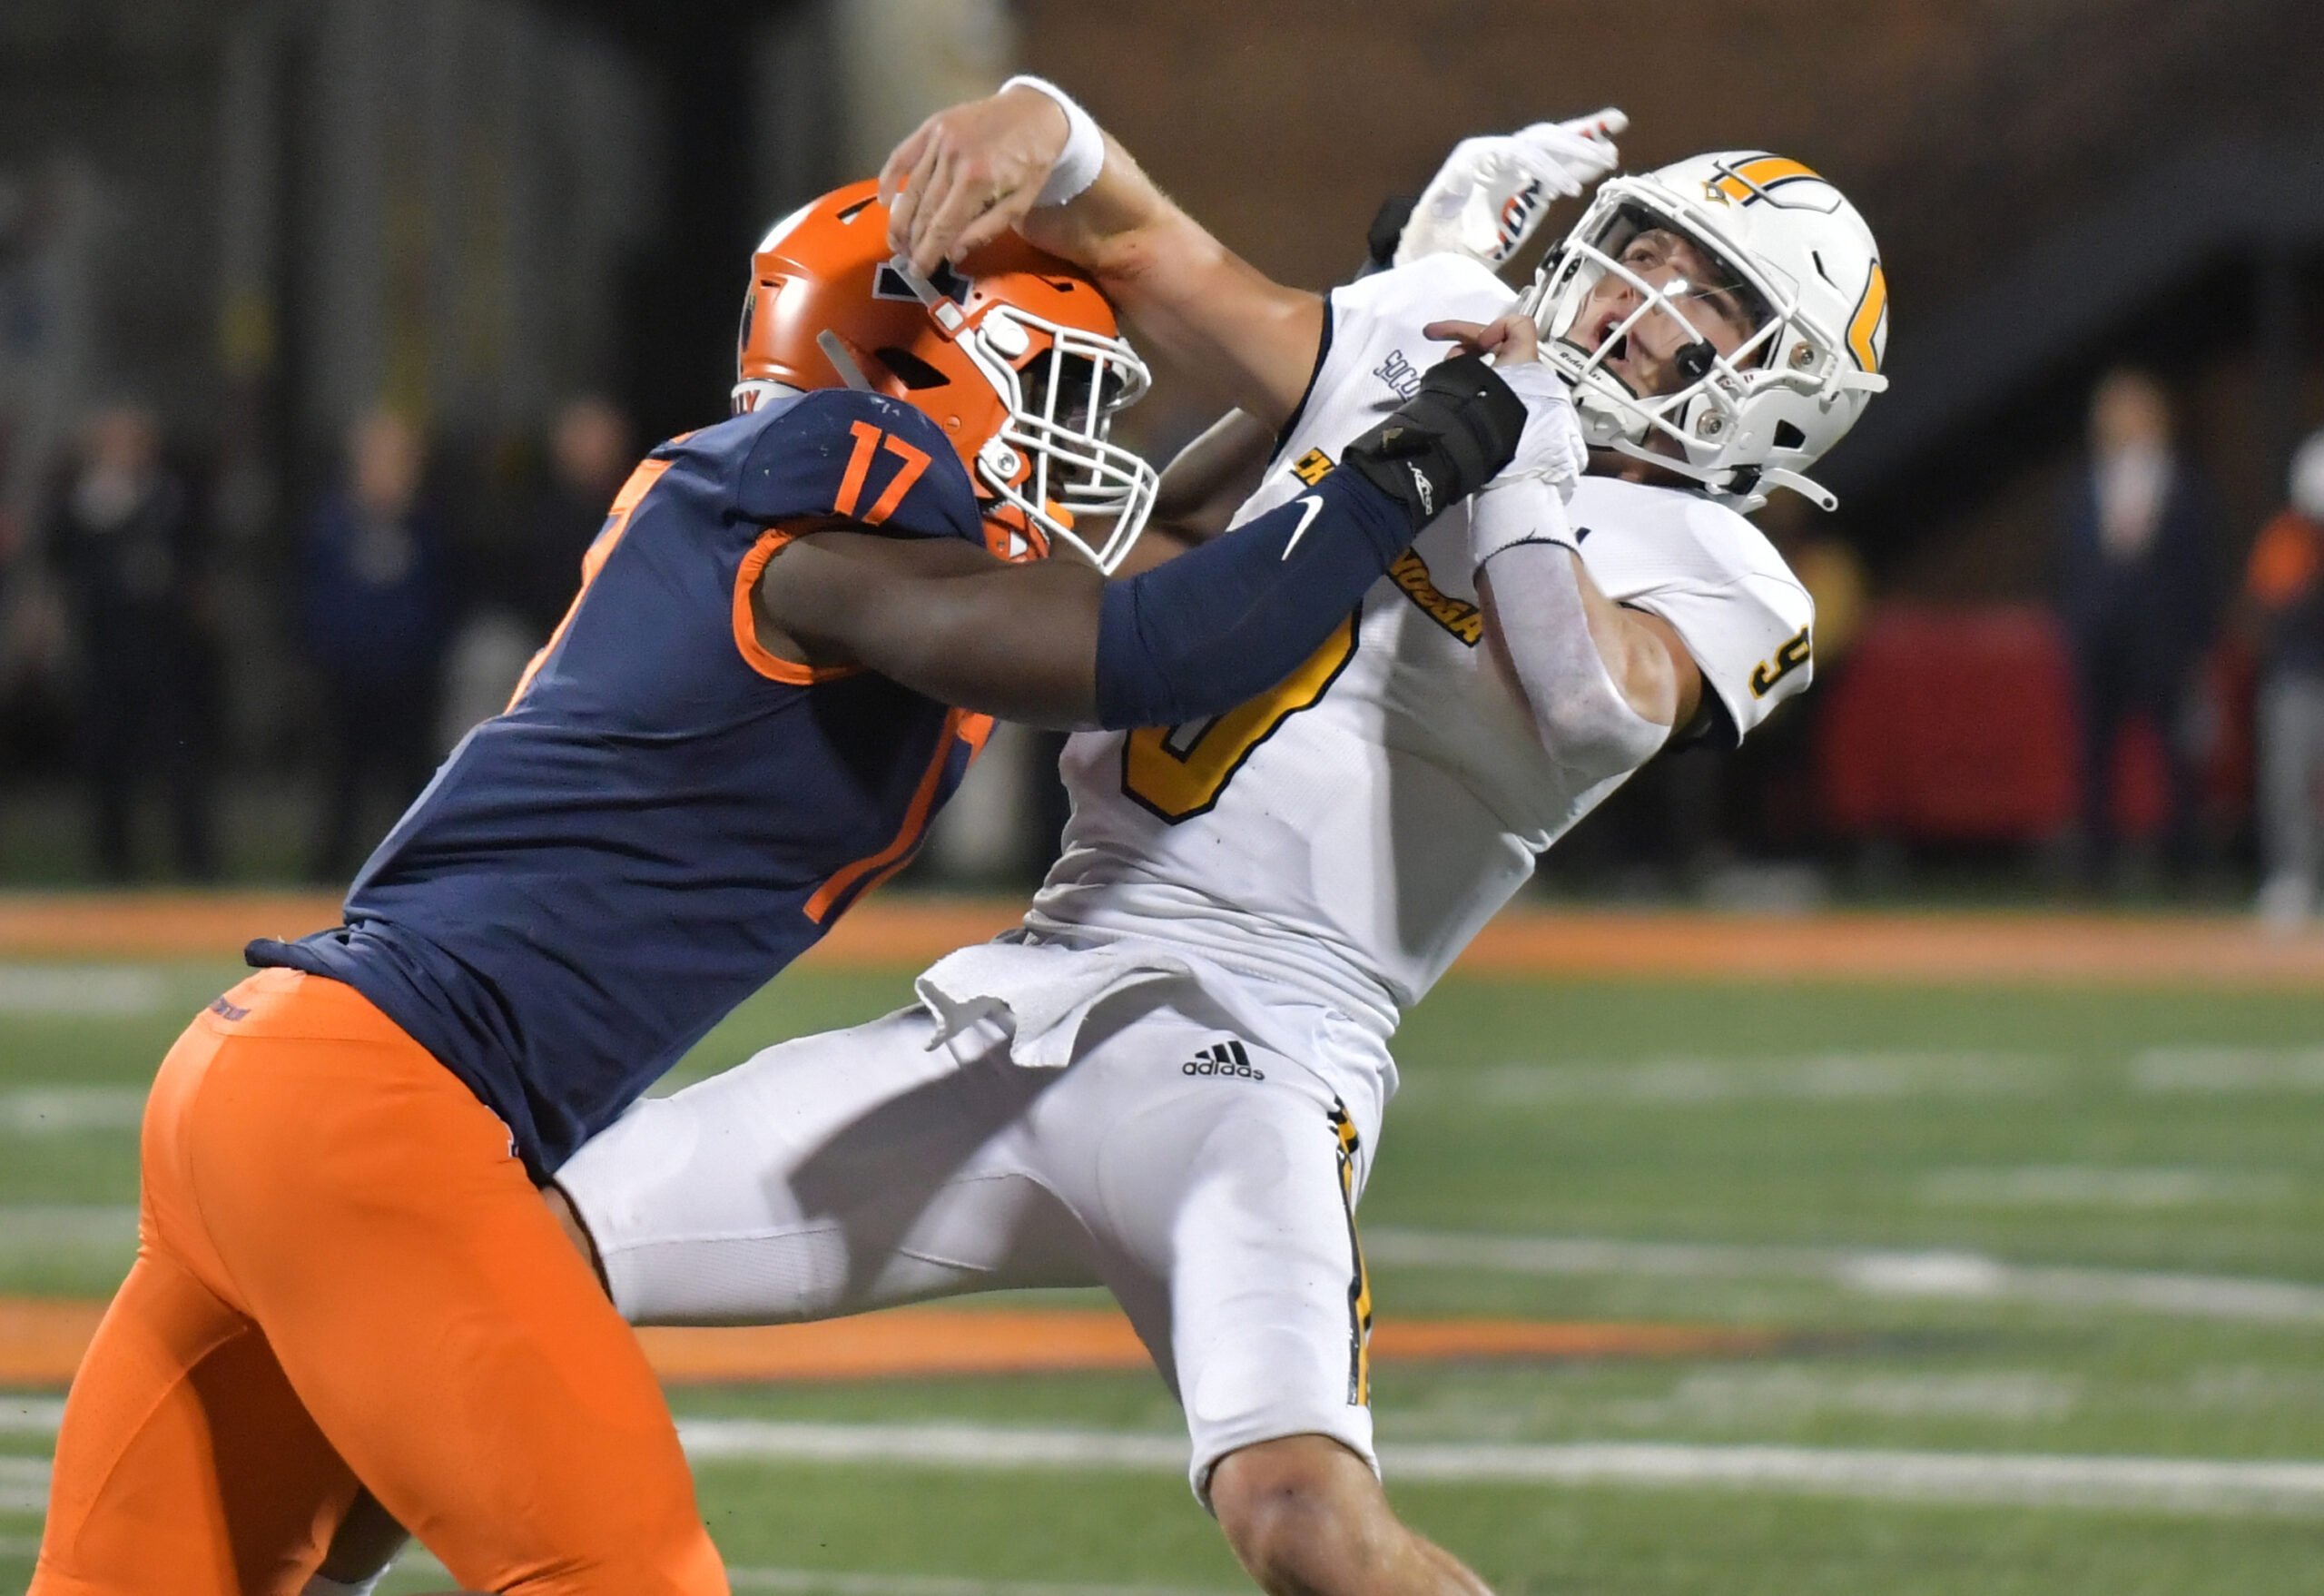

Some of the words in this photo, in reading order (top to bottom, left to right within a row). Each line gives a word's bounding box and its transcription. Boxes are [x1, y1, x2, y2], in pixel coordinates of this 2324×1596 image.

[1372, 349, 1423, 403] SOCO
[833, 419, 932, 527] 17
[1182, 1057, 1265, 1081] adidas
